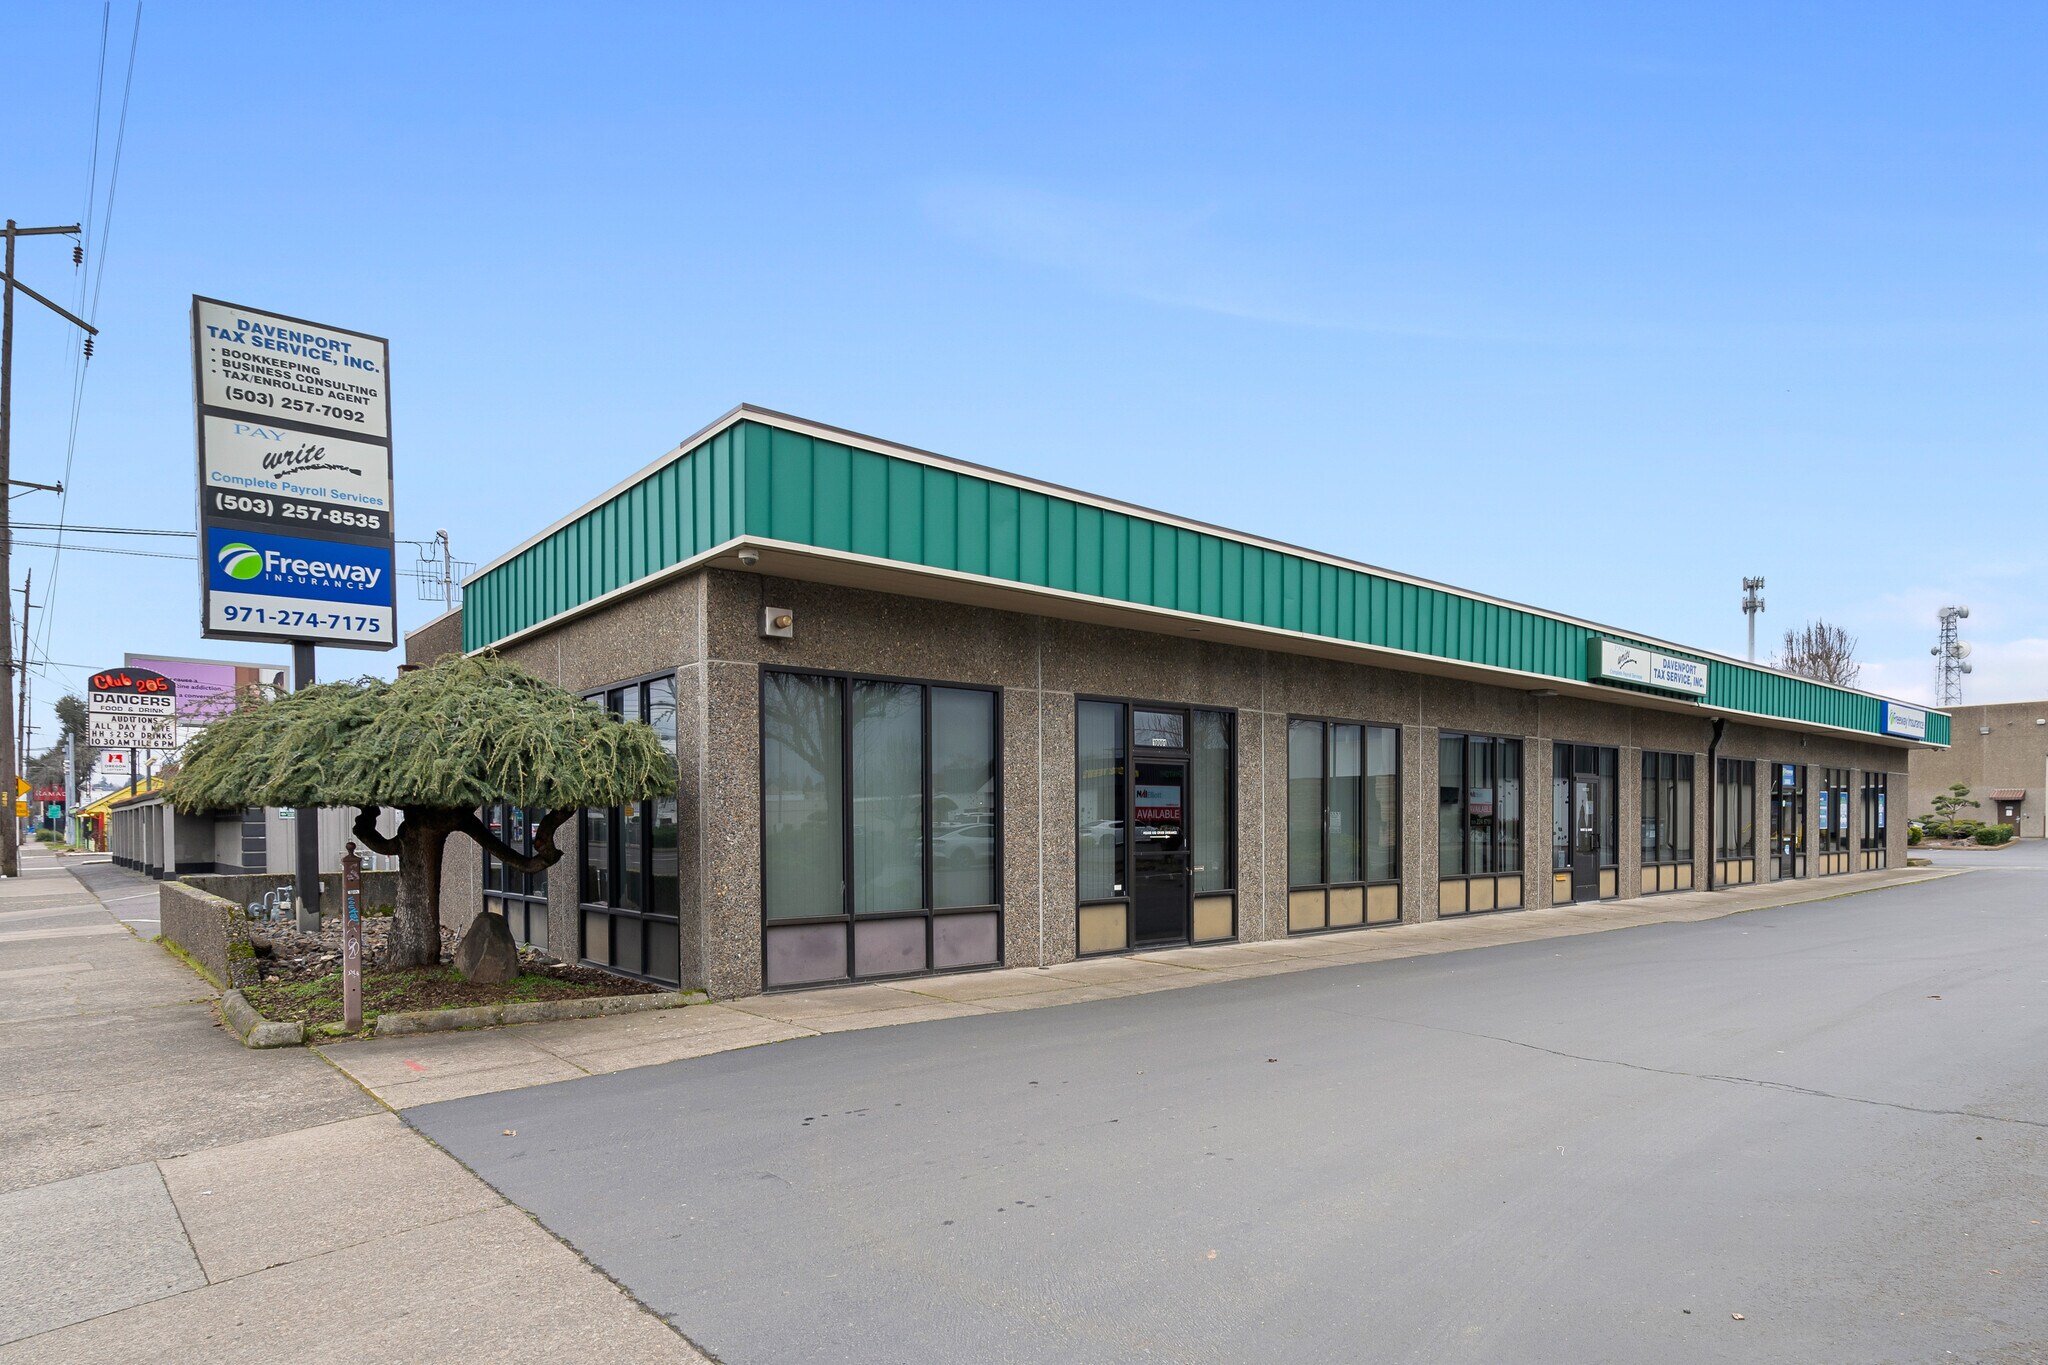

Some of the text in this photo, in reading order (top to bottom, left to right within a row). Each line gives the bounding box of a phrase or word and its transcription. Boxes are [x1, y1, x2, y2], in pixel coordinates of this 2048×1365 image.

[206, 325, 380, 373] TAX SERVICE, INC.
[237, 319, 352, 354] DAVENPORT
[222, 348, 320, 375] BOOKKEEPING
[222, 359, 378, 398] BUSINESS CONSULTING
[222, 369, 370, 406] TAX/ENROLLED AGENT
[225, 386, 365, 423] (503) 257-7092
[233, 423, 286, 442] PAY
[262, 443, 327, 470] write
[211, 471, 384, 506] Complete Payroll Services
[215, 492, 380, 529] (503) 257-8535
[265, 550, 381, 588] Freeway
[265, 574, 364, 590] INSURANCE
[224, 605, 381, 633] 971-274-7175
[1653, 668, 1704, 688] TAX SERVICE, INC.
[1662, 658, 1697, 675] DAVENPORT
[93, 672, 169, 693] Club 205
[93, 694, 171, 707] DANCERS
[111, 716, 158, 724] AUDITIONS
[104, 738, 115, 746] 30
[1136, 809, 1180, 819] AVAILABLE
